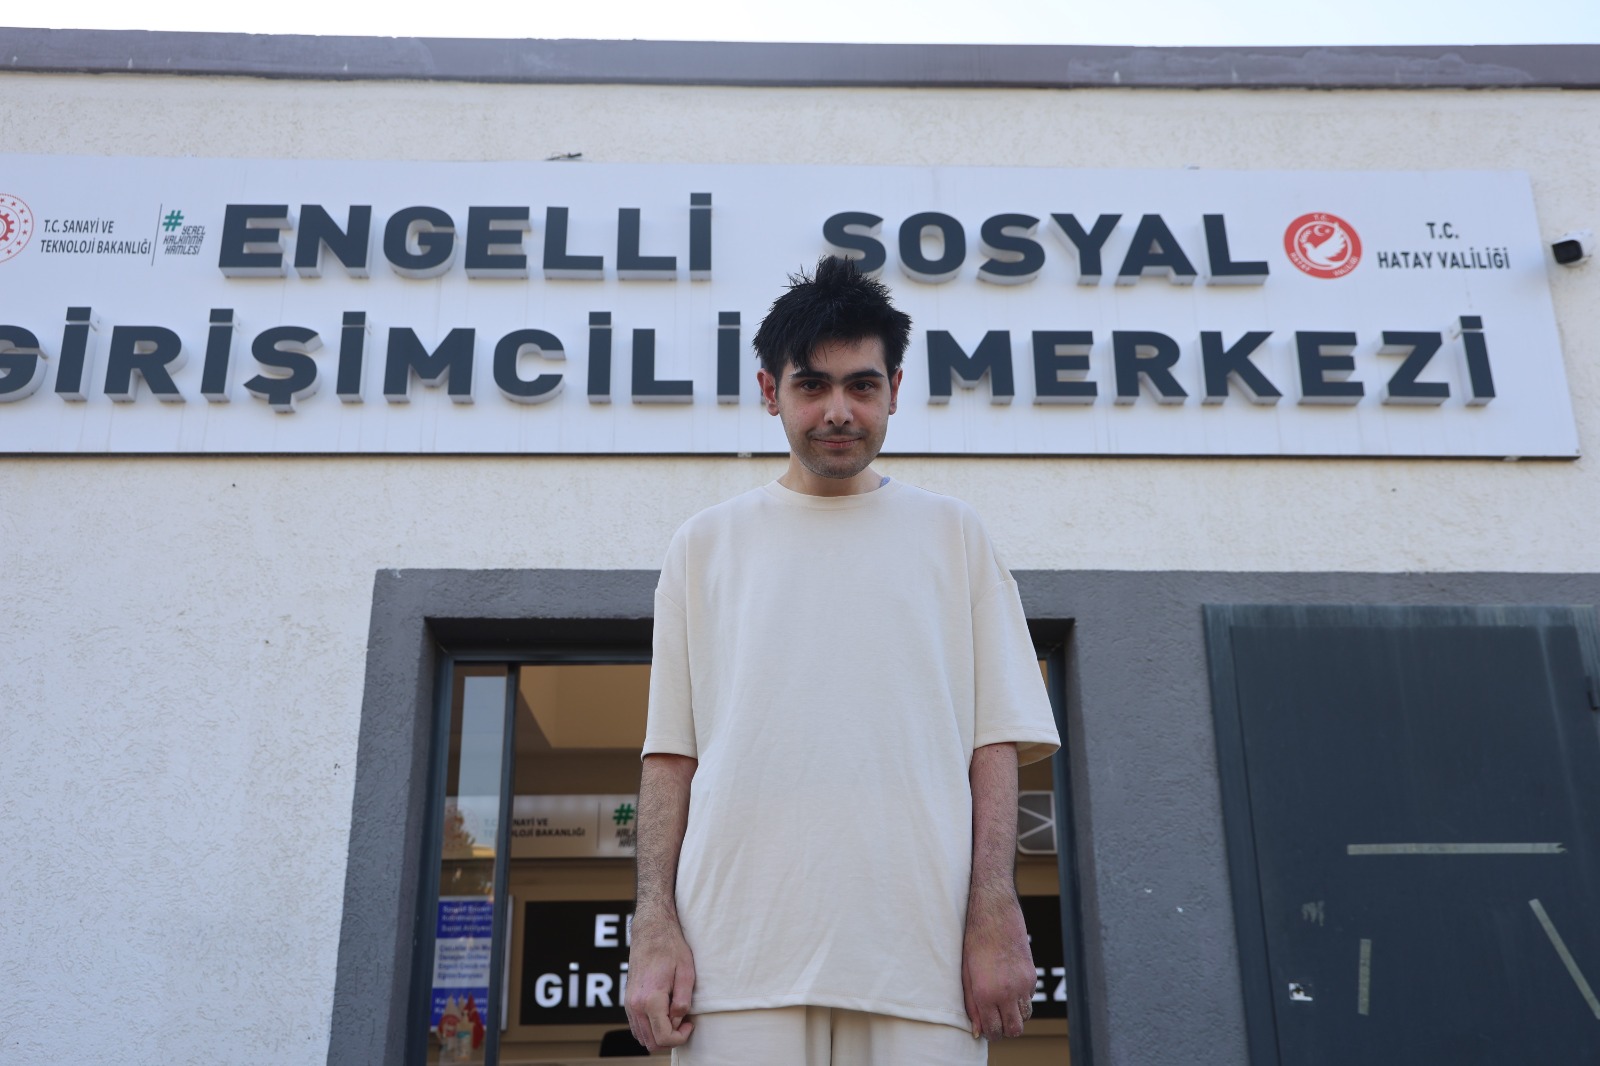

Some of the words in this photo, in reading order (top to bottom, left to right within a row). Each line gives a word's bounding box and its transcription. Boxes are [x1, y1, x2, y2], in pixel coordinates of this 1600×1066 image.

[44, 219, 60, 233] T.C.
[62, 217, 100, 233] SANAYİ
[101, 220, 115, 234] VE
[1426, 222, 1459, 239] T.C.
[40, 237, 95, 254] TEKNOLOJİ
[96, 238, 151, 254] BAKANLIĞI
[219, 192, 713, 273] ENGELLİ
[824, 212, 1269, 280] SOSYAL
[1377, 251, 1433, 269] HATAY
[1439, 246, 1511, 269] VALİLİĞİ
[0, 308, 764, 408] GİRİŞİMCİLİ
[927, 317, 1497, 400] MERKEZİ
